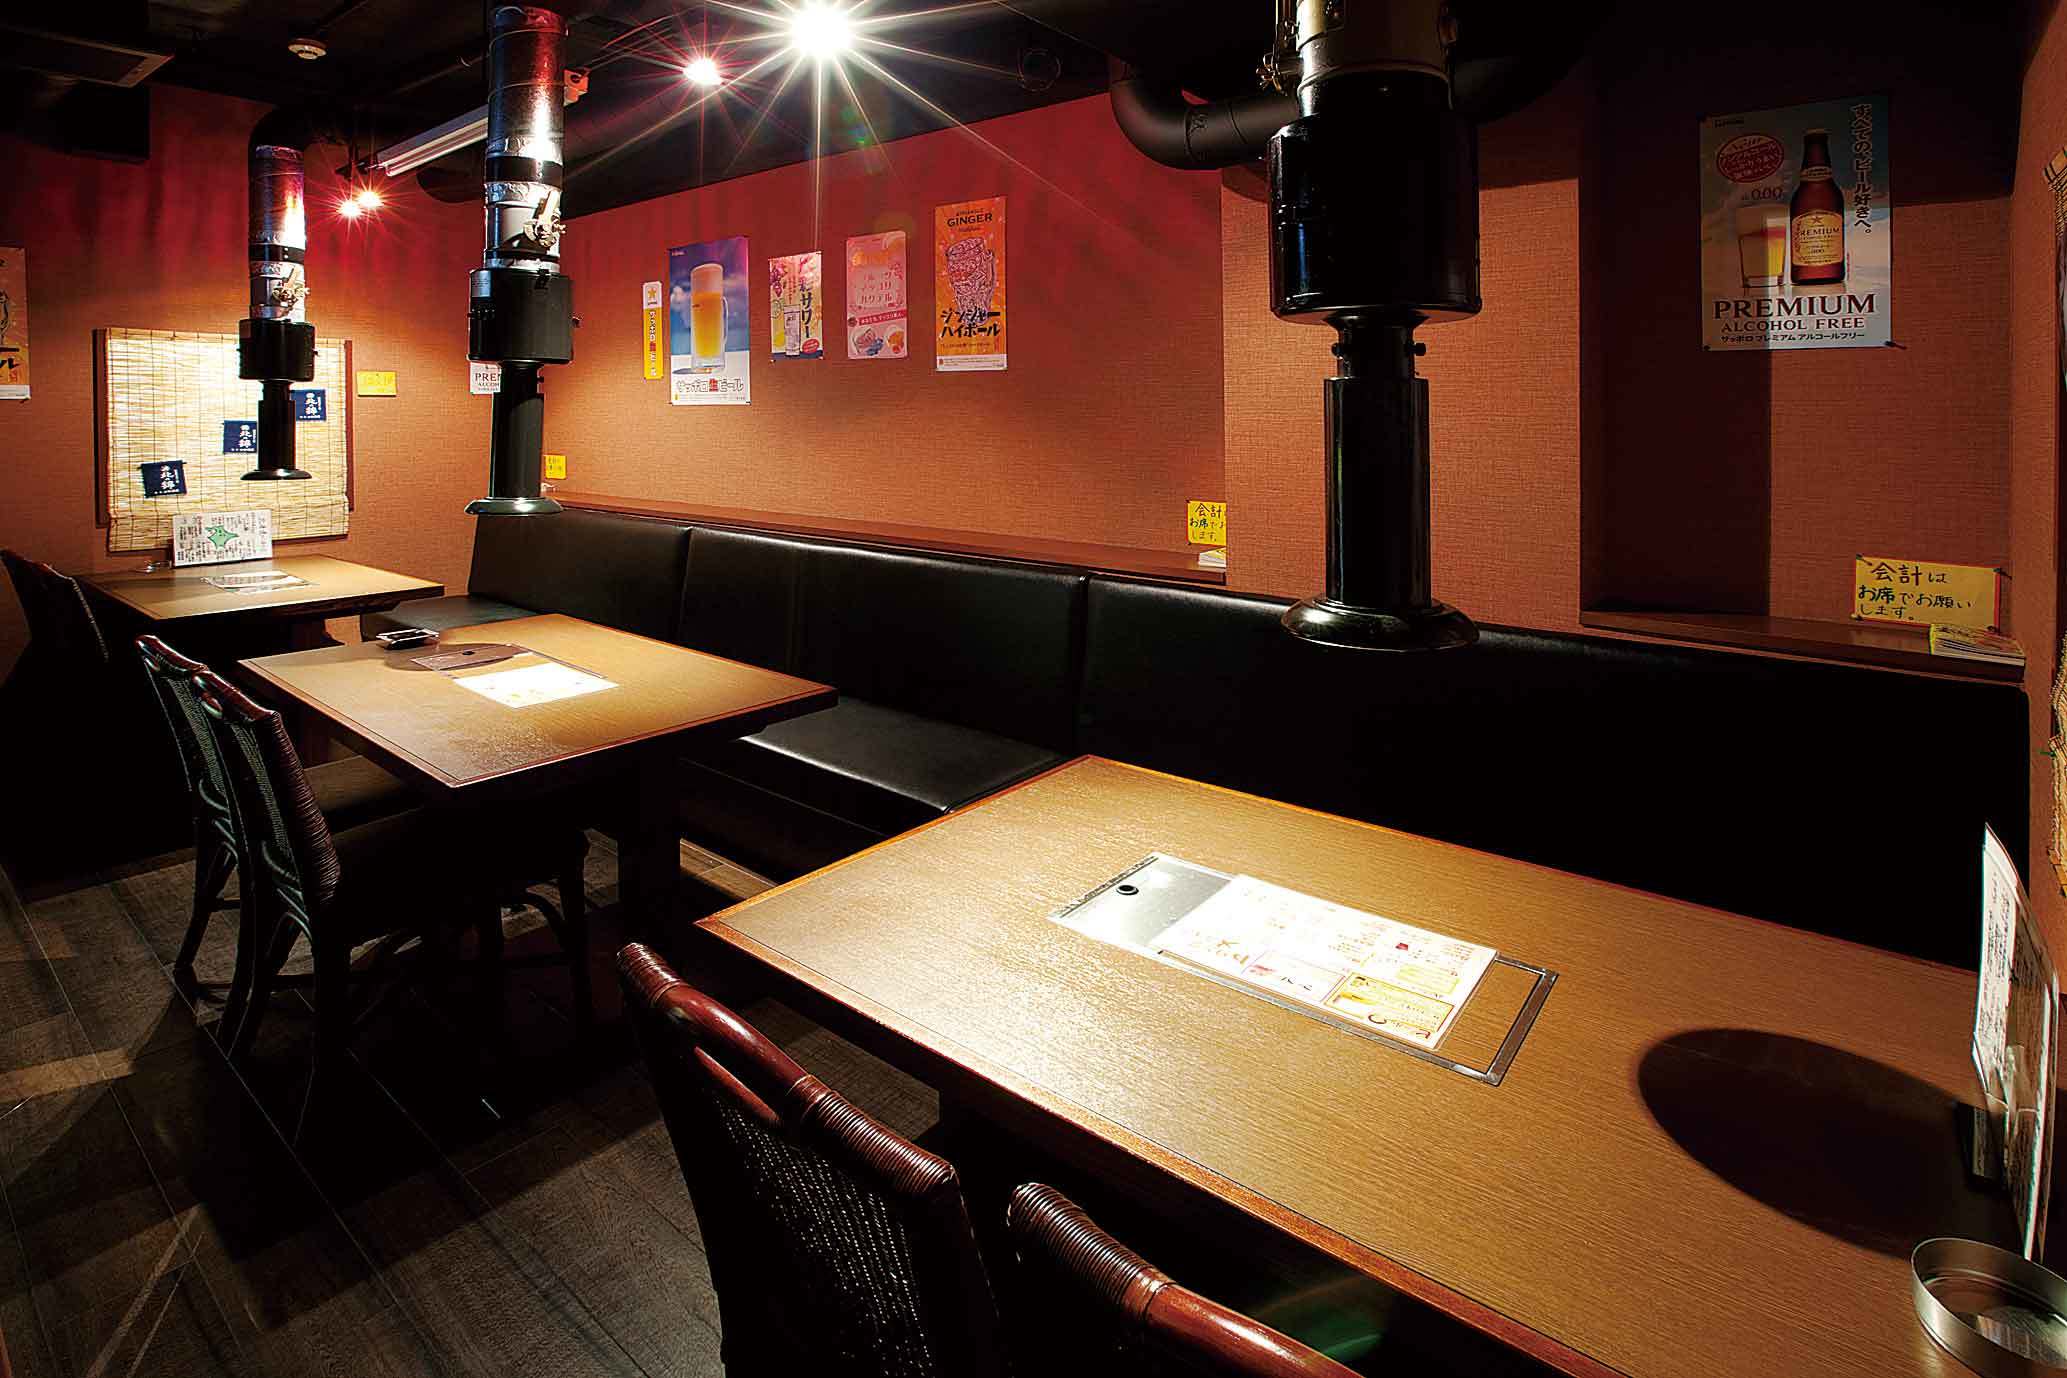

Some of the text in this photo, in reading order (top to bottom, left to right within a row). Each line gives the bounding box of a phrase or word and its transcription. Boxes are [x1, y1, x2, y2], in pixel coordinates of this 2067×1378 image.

[947, 212, 992, 227] GINGER
[1714, 293, 1876, 319] PREMIUM
[941, 323, 1001, 339] ハイボール
[1720, 317, 1865, 333] ALCOHOL FREE
[475, 372, 500, 382] PRE
[1195, 503, 1221, 518] 会計
[1871, 562, 1948, 586] 会計は
[1858, 585, 1971, 609] お席でお願い
